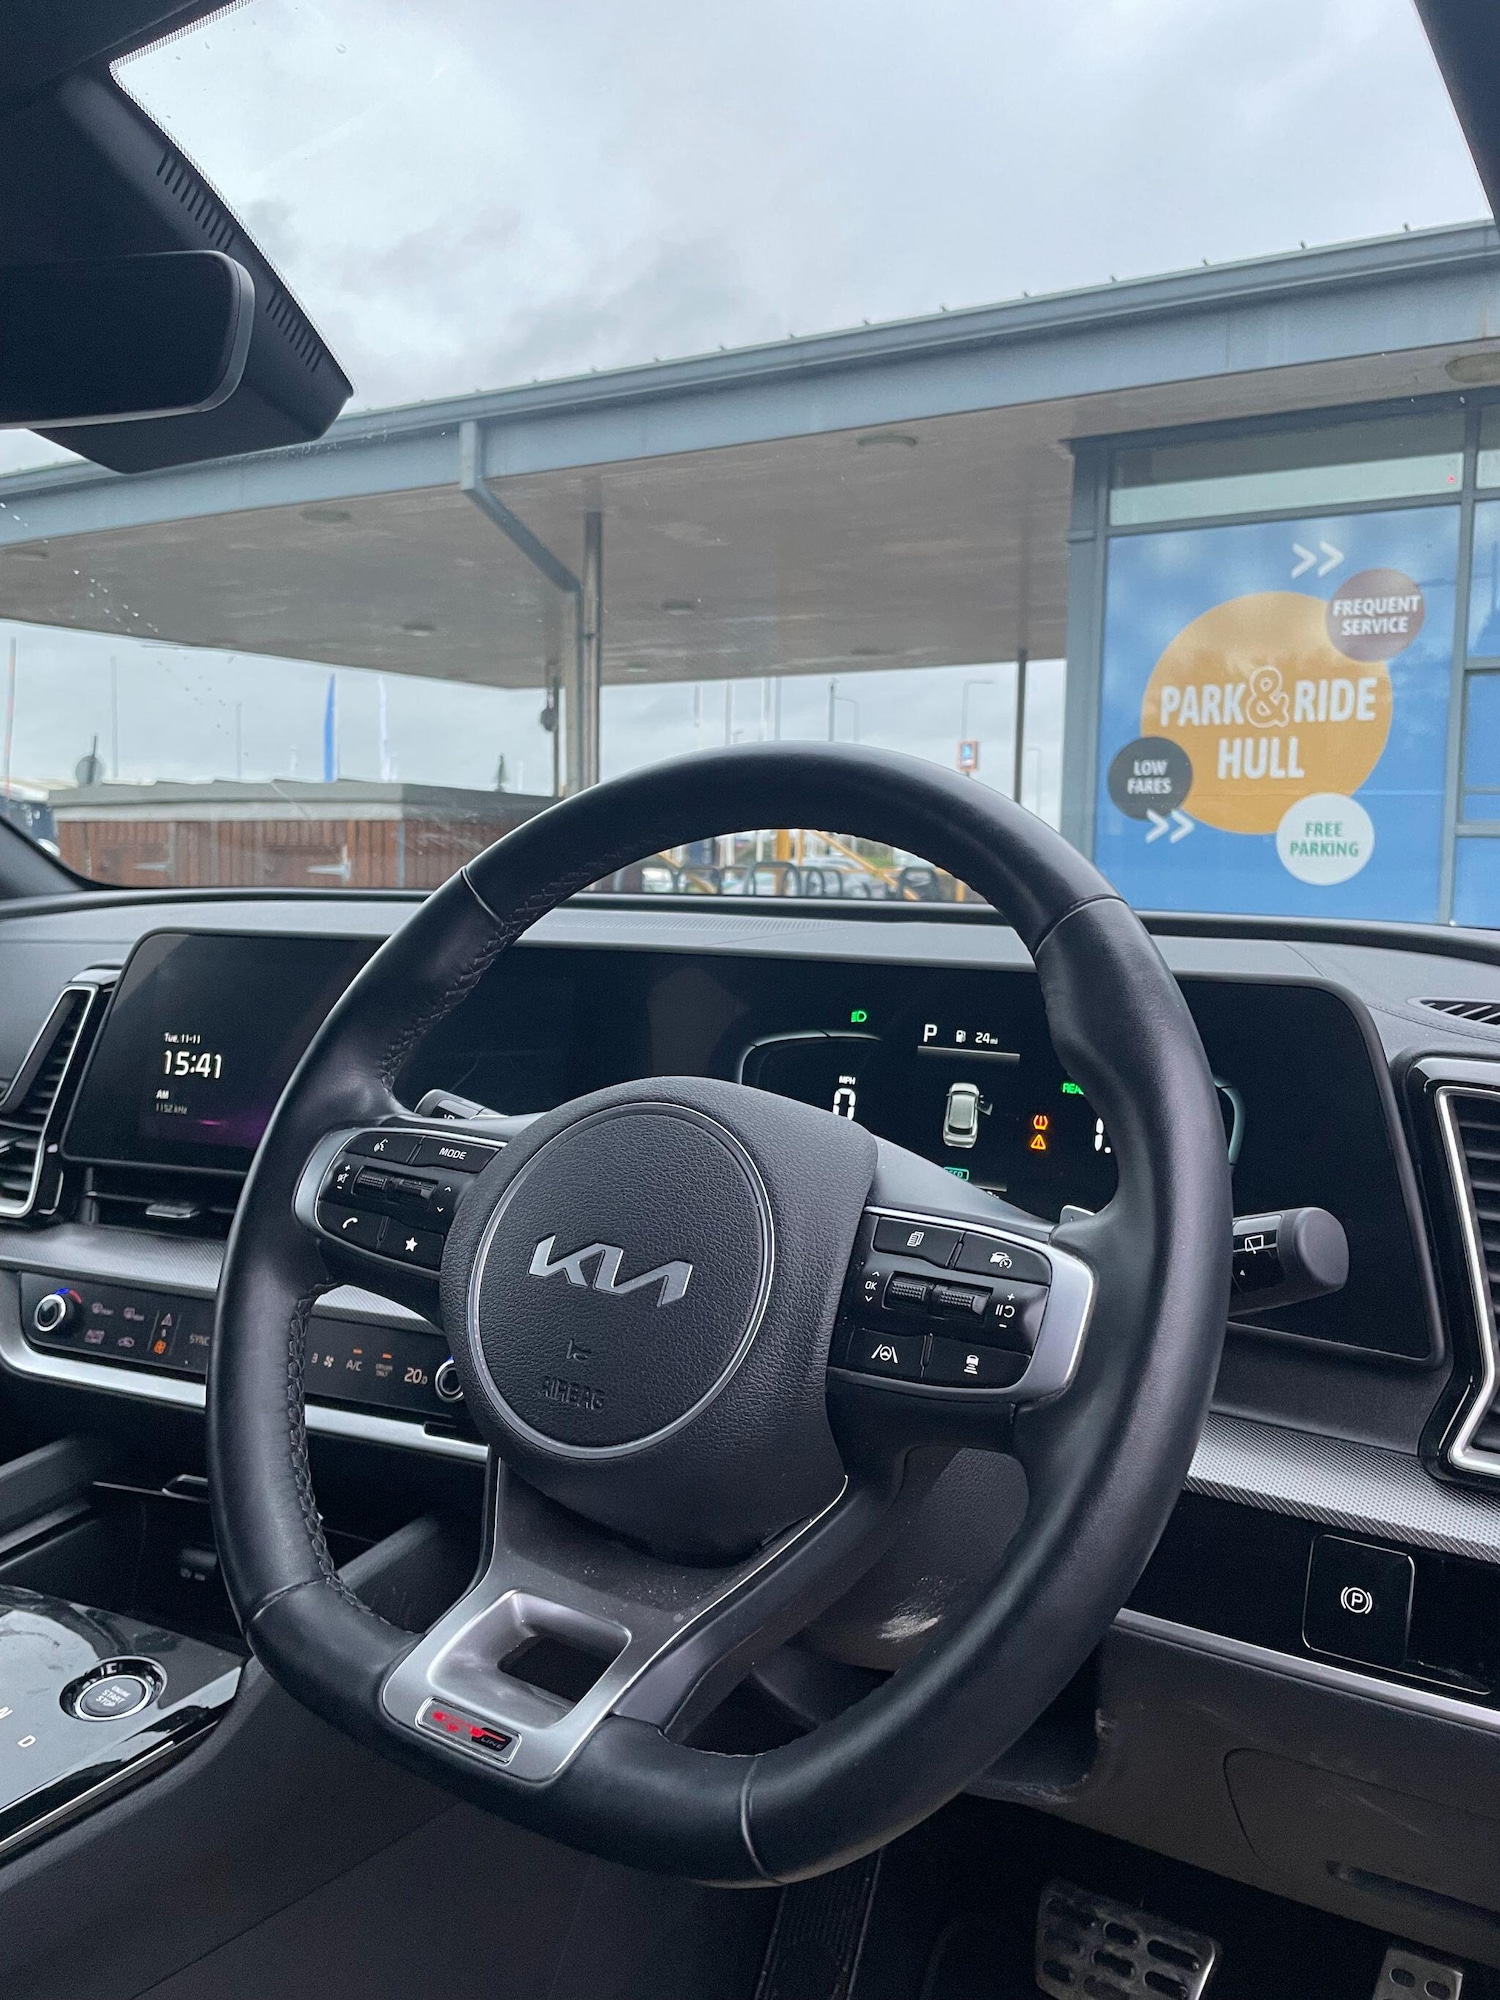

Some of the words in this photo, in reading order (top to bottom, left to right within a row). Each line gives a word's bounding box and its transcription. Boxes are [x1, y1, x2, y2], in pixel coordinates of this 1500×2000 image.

[1333, 594, 1420, 617] FREQUENT
[1341, 615, 1409, 636] SERVICE
[1217, 736, 1305, 780] HULL
[1133, 759, 1169, 776] LOW
[1127, 777, 1172, 795] FARES
[1305, 821, 1343, 837] FREE
[1289, 840, 1359, 858] PARKING
[923, 1023, 938, 1043] P
[164, 1049, 222, 1079] 15:41
[838, 1075, 856, 1086] MPH
[155, 1088, 170, 1100] AM
[438, 1147, 468, 1161] MODE
[864, 1280, 878, 1292] OK
[345, 1359, 363, 1372] A/C
